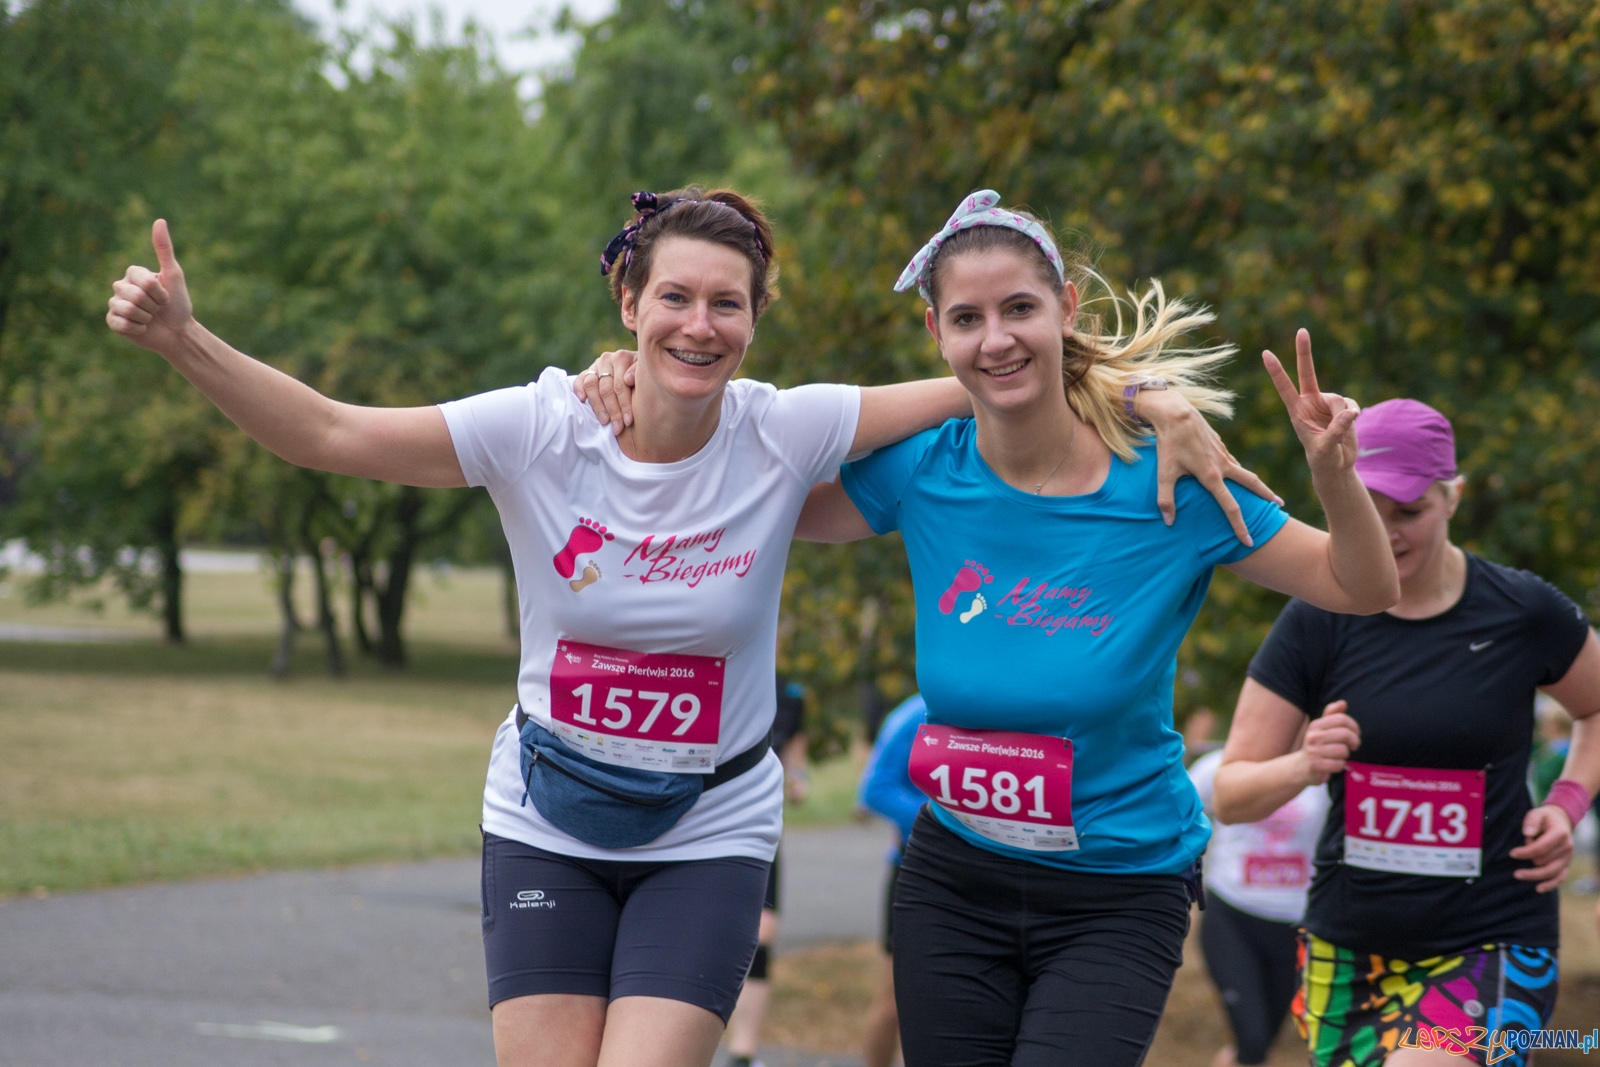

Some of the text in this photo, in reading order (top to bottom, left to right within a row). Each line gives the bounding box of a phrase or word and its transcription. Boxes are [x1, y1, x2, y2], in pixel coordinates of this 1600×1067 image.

[623, 527, 727, 567] Mamy
[996, 576, 1094, 609] Mamy
[591, 658, 627, 674] Zawsze
[628, 664, 668, 678] Pier(w)si
[669, 667, 695, 679] 2016
[571, 682, 701, 737] 1579
[947, 739, 981, 753] Zawsze
[981, 743, 1020, 757] Pier(w)si
[1020, 747, 1045, 760] 2016
[929, 764, 1053, 820] 1581
[1358, 797, 1467, 843] 1713
